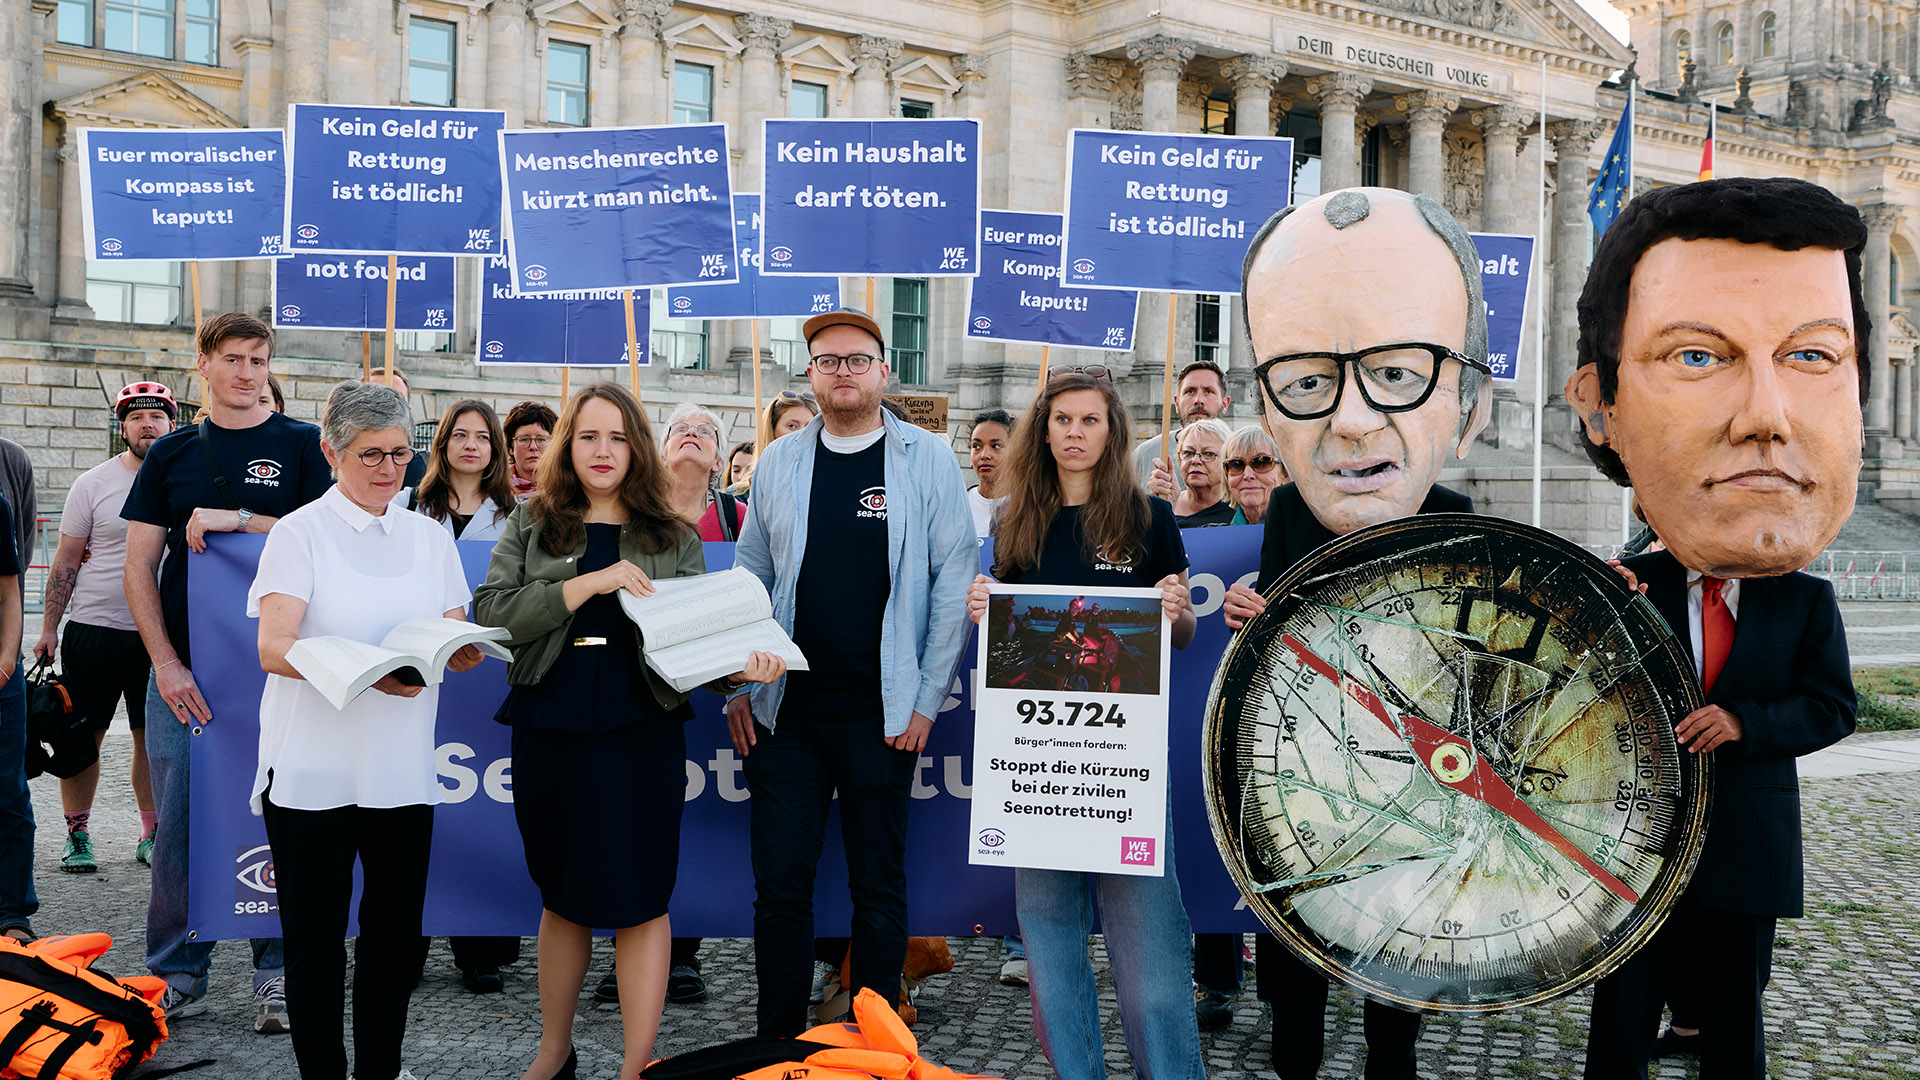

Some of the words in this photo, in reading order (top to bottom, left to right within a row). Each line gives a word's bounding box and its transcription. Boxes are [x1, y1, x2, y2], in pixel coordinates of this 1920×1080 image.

[1298, 36, 1333, 56] DEM
[1346, 46, 1434, 77] DEUTSCHEN
[1446, 66, 1488, 88] VOLKE
[322, 118, 376, 136] Kein
[381, 119, 438, 138] Geld
[442, 120, 479, 140] für
[97, 146, 146, 162] Euer
[150, 146, 277, 162] moralischer
[515, 145, 719, 172] Menschenrechte
[777, 140, 838, 163] Kein
[845, 140, 967, 164] Haushalt
[1100, 144, 1156, 166] Kein
[1161, 148, 1220, 169] Geld
[1224, 148, 1263, 170] für
[348, 150, 446, 176] Rettung
[126, 178, 224, 197] Kompass
[227, 177, 256, 192] ist
[332, 180, 364, 200] ist
[368, 182, 463, 203] tödlich!
[1126, 180, 1228, 208] Rettung
[522, 190, 589, 210] kürzt
[594, 189, 643, 208] man
[648, 184, 718, 205] nicht.
[794, 184, 857, 208] darf
[860, 186, 946, 208] töten.
[152, 208, 234, 228] kaputt!
[1109, 212, 1142, 234] ist
[1146, 215, 1245, 239] tödlich!
[260, 236, 281, 244] WE
[468, 229, 490, 240] WE
[984, 227, 1025, 244] Euer
[464, 239, 494, 250] ACT
[943, 247, 966, 258] WE
[701, 254, 724, 266] WE
[939, 258, 968, 269] ACT
[306, 262, 350, 278] not
[698, 265, 728, 278] ACT
[525, 280, 549, 288] sea-eye
[812, 294, 831, 303] WE
[1020, 290, 1088, 312] kaputt!
[426, 309, 445, 318] WE
[810, 303, 834, 312] ACT
[424, 318, 448, 327] ACT
[1106, 327, 1125, 337] WE
[1102, 336, 1126, 347] ACT
[620, 351, 644, 361] AT
[1490, 363, 1509, 374] CT
[244, 476, 280, 488] sea-eye
[1094, 562, 1134, 574] sea-eye
[1016, 699, 1127, 728] 93.724
[1083, 740, 1127, 750] fordern:
[1614, 721, 1633, 754] 300
[989, 758, 1048, 776] Stoppt
[1051, 760, 1077, 775] die
[1080, 762, 1150, 782] Kürzung
[1011, 779, 1037, 794] bei
[1040, 780, 1069, 795] der
[1072, 783, 1126, 798] zivilen
[1614, 780, 1633, 812] 320
[1003, 800, 1133, 824] Seenotrettung!
[978, 848, 1006, 856] sea-eye
[1128, 841, 1148, 852] WE
[1124, 851, 1151, 862] ACT
[234, 900, 280, 915] sea-
[1500, 909, 1522, 928] 20
[1442, 920, 1464, 936] 40
